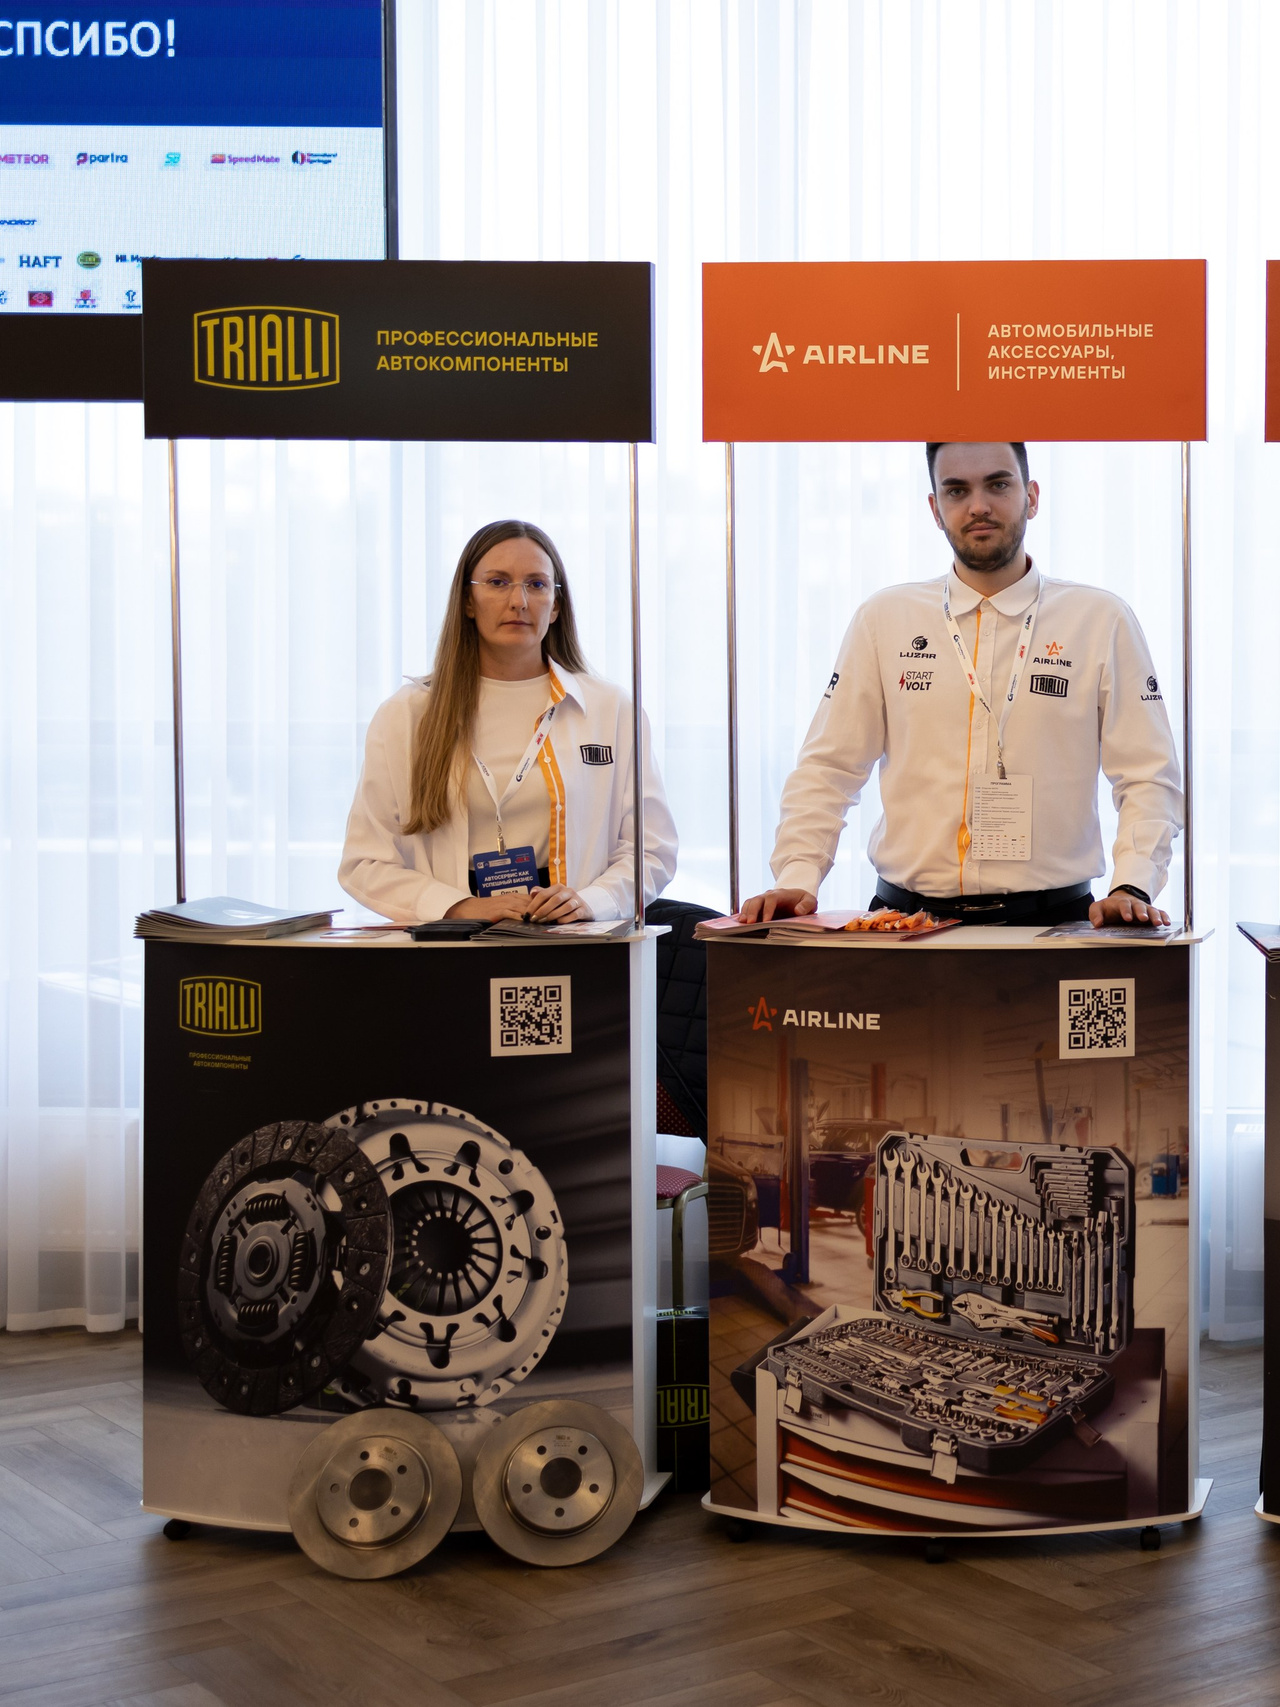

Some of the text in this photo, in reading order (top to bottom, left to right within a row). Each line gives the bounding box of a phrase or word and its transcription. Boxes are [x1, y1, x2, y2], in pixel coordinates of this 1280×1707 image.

[0, 19, 175, 58] СПСИБО!
[19, 255, 62, 268] HAFT
[376, 330, 599, 348] ПРОФЕССИОНАЛЬНЫЕ
[987, 323, 1155, 339] АВТОМОБИЛЬНЫЕ
[201, 313, 331, 382] TRIALLI
[802, 344, 930, 365] AIRLINE
[987, 344, 1116, 361] АКСЕССУАРЫ,
[376, 355, 569, 373] АВТОКОМПОНЕНТЫ
[987, 365, 1127, 380] ИНСТРУМЕНТЫ
[899, 651, 937, 660] LUZAR
[1032, 656, 1073, 668] AIRLINE
[905, 670, 935, 681] START
[905, 681, 932, 691] VOLT
[1035, 677, 1065, 694] TRIALLI
[583, 747, 609, 763] TRIALLI
[484, 872, 519, 882] АВТОСЕРВИС
[513, 876, 534, 884] БИЗНЕС
[183, 981, 256, 1031] TRIALLI
[782, 1008, 881, 1031] AIRLINE
[188, 1051, 252, 1063] ПРОФЕССИОНАЛЬНЫЕ
[193, 1060, 249, 1070] АВТОКОМПОНЕНТЫ
